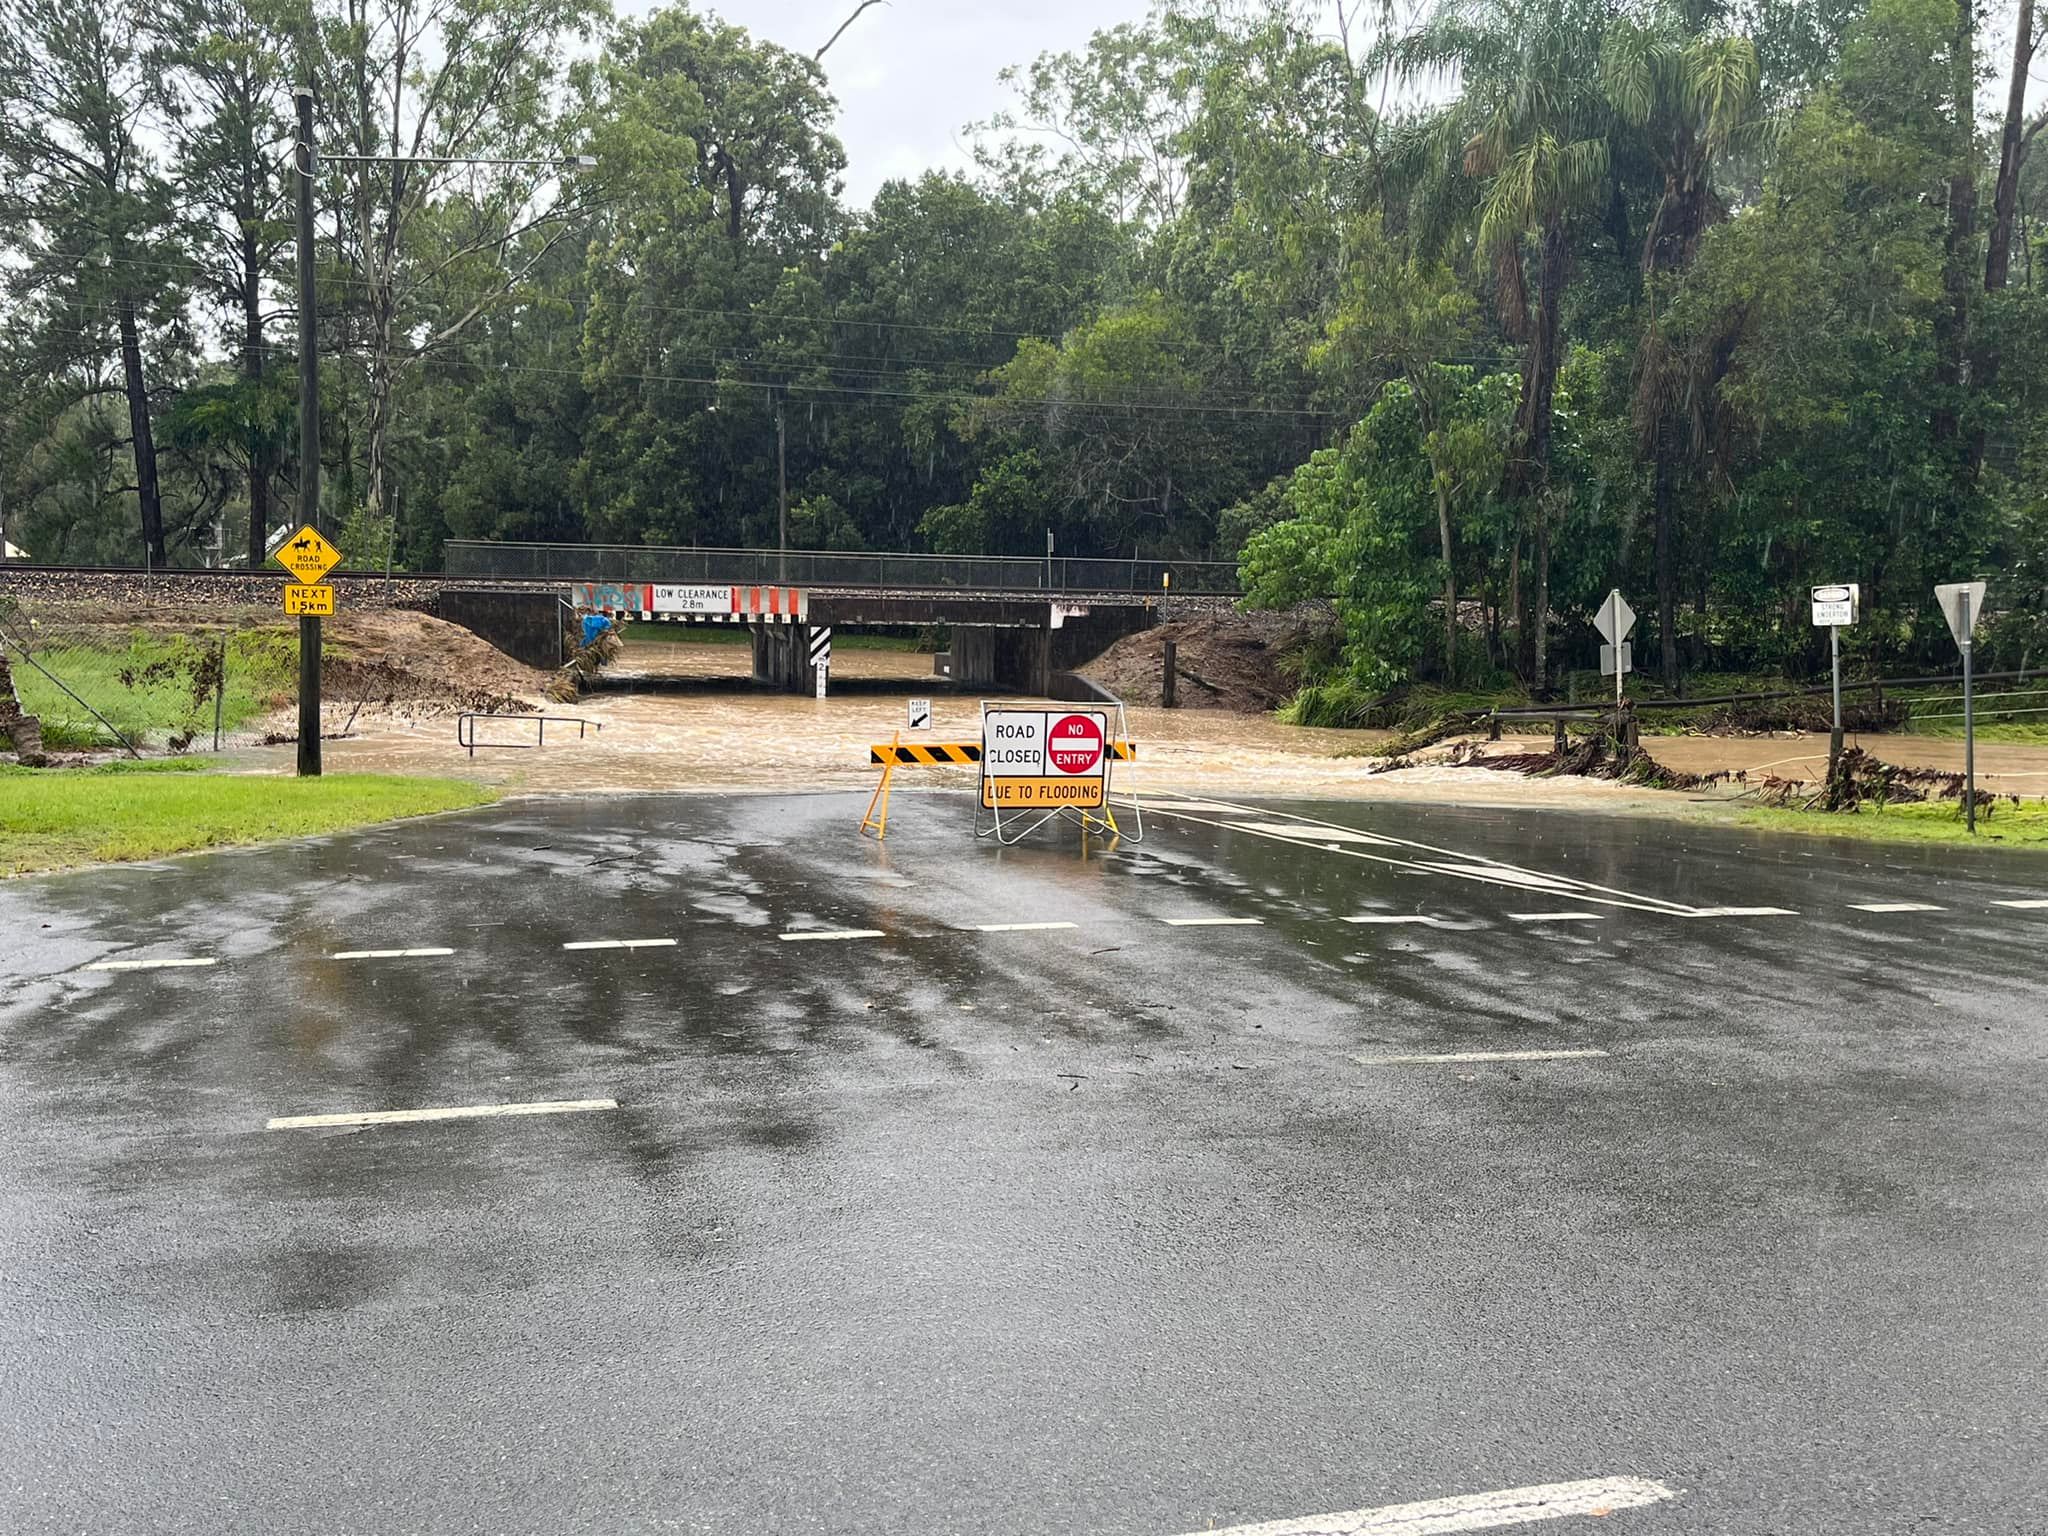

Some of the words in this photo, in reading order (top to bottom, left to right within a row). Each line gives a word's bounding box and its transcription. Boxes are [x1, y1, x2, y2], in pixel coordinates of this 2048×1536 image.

[297, 555, 320, 563] ROAD
[290, 563, 328, 571] CROSSING
[291, 589, 327, 599] NEXT
[655, 588, 674, 599] LOW
[677, 588, 728, 600] CLEARANCE
[291, 601, 328, 611] 1.5km
[681, 600, 704, 609] 2.8m
[996, 725, 1035, 738] ROAD
[1068, 724, 1084, 736] NO
[989, 749, 1041, 764] CLOSED
[1056, 753, 1093, 765] ENTRY
[987, 785, 1012, 799] DUE
[1018, 785, 1033, 799] TO
[1039, 785, 1098, 799] FLOODING
